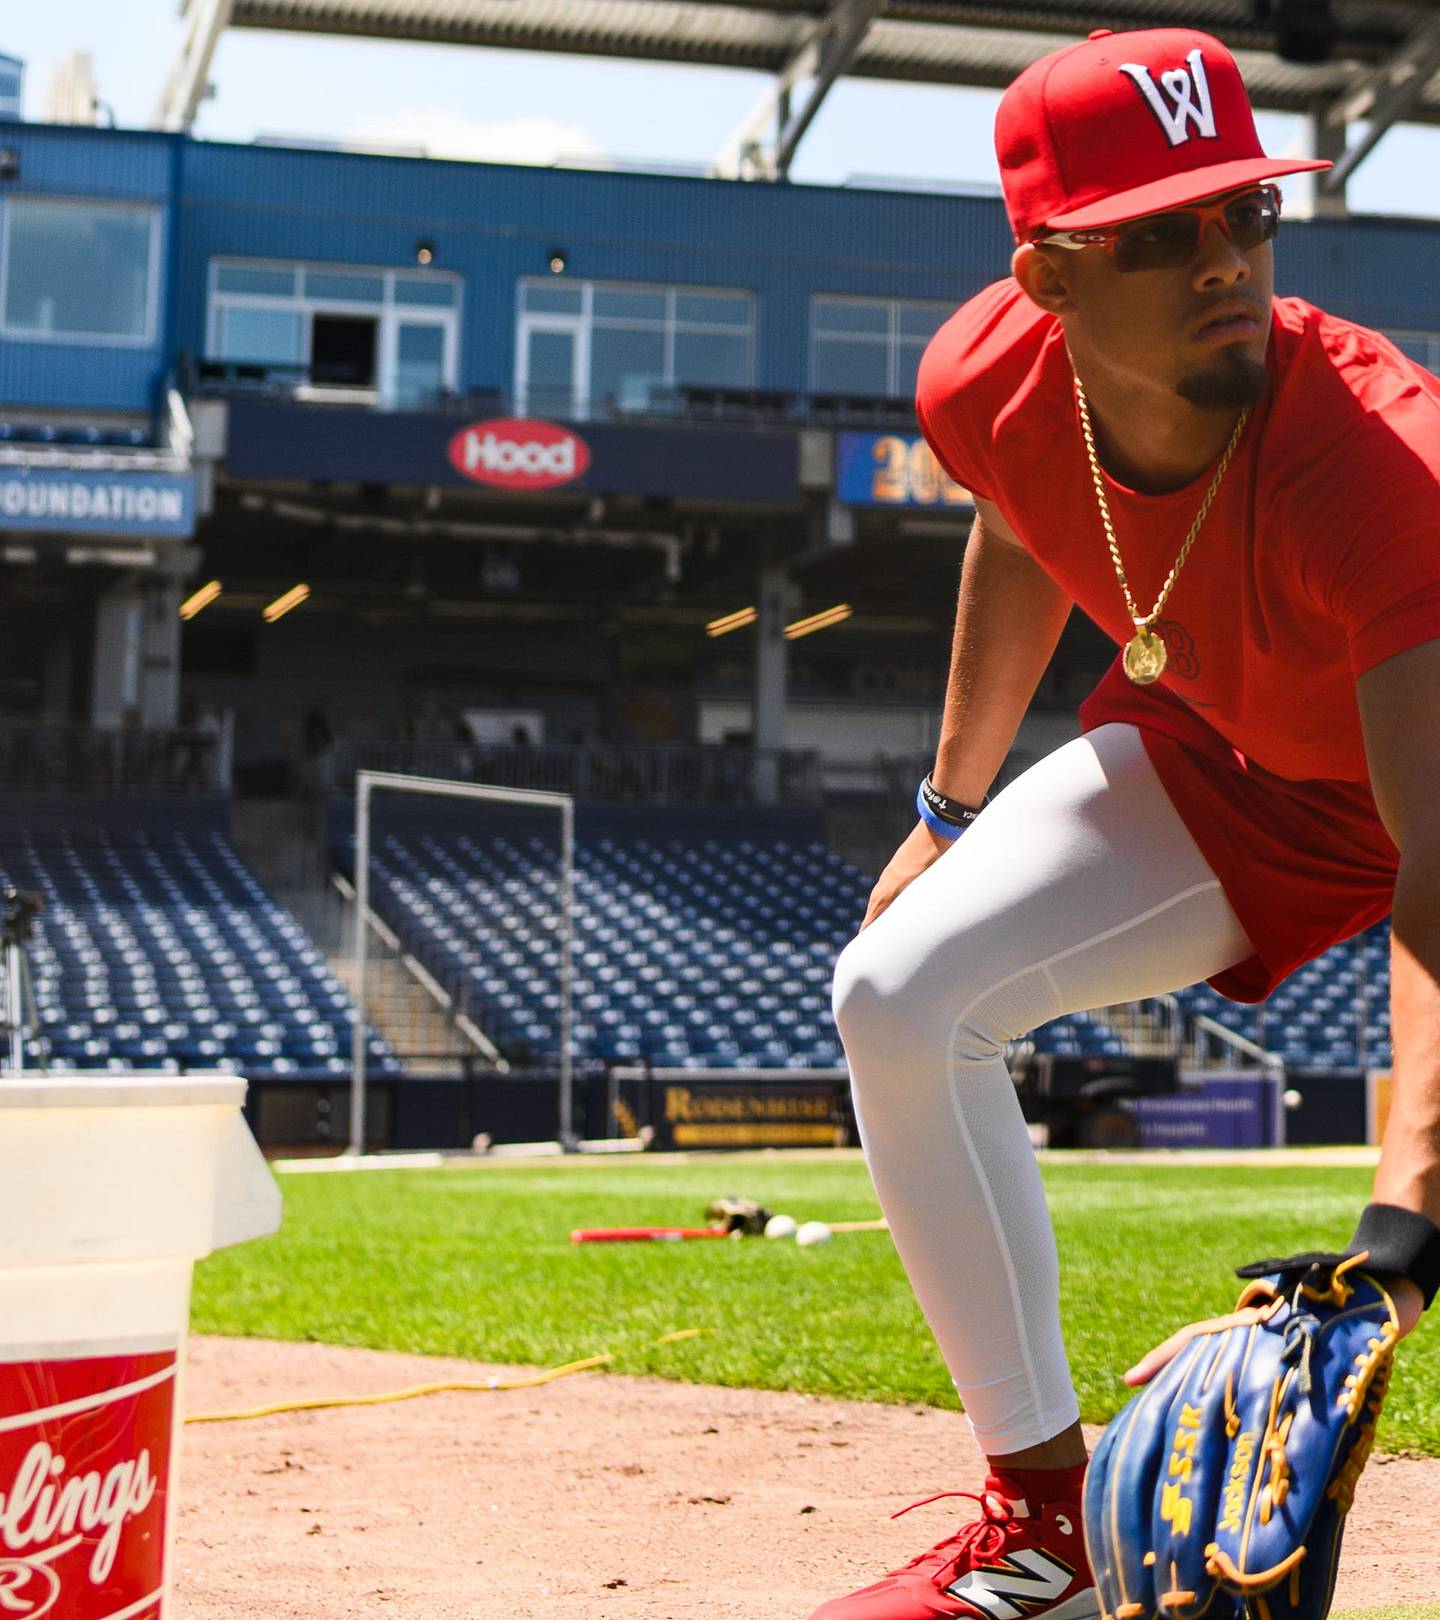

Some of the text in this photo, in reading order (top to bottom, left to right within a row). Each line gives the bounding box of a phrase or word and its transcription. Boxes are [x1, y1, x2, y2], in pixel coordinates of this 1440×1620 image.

[1118, 49, 1218, 146] W
[464, 430, 575, 476] Hood
[0, 481, 183, 521] OUNDATION
[1168, 1402, 1204, 1483] SSK
[1217, 1432, 1258, 1534] Jackson
[0, 1441, 157, 1585] lings
